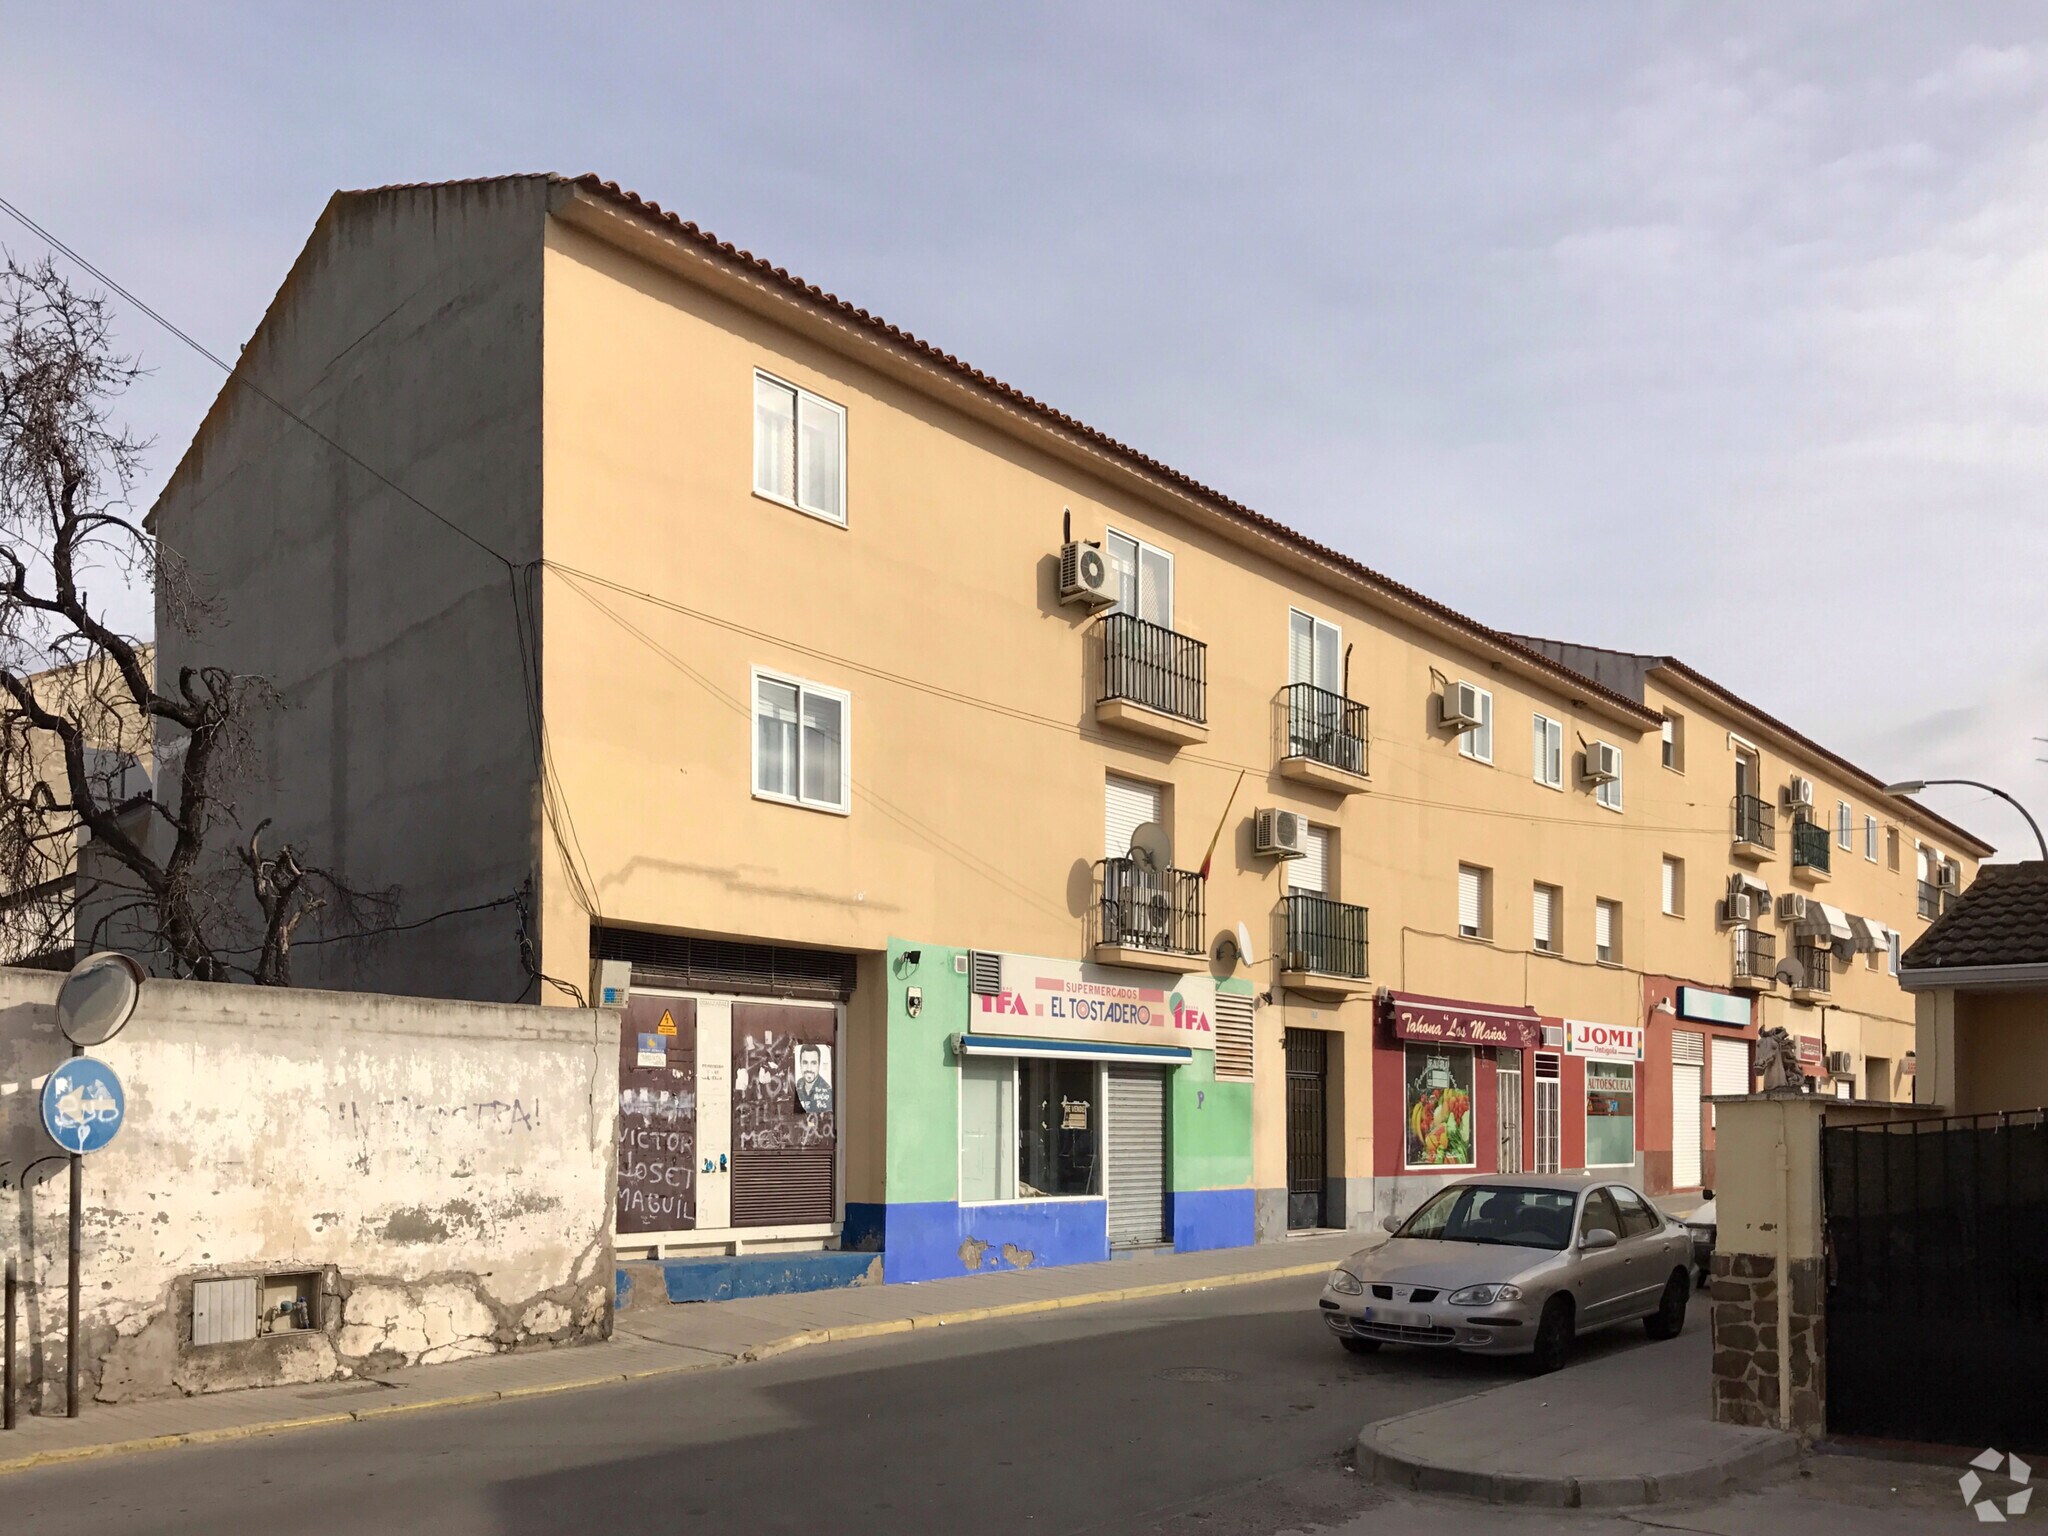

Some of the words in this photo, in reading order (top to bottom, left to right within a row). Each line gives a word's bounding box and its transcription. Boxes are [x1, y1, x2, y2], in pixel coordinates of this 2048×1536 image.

[1066, 982, 1137, 1000] SUPERMERCADOS
[1051, 996, 1066, 1018] EL
[1069, 997, 1151, 1025] TOSTADERO
[1173, 998, 1211, 1032] IFA
[1401, 1012, 1443, 1036] Tahona
[1577, 1026, 1633, 1048] JOMI
[1588, 1078, 1632, 1091] AUTOESCUELA
[618, 1127, 694, 1154] VICTOR
